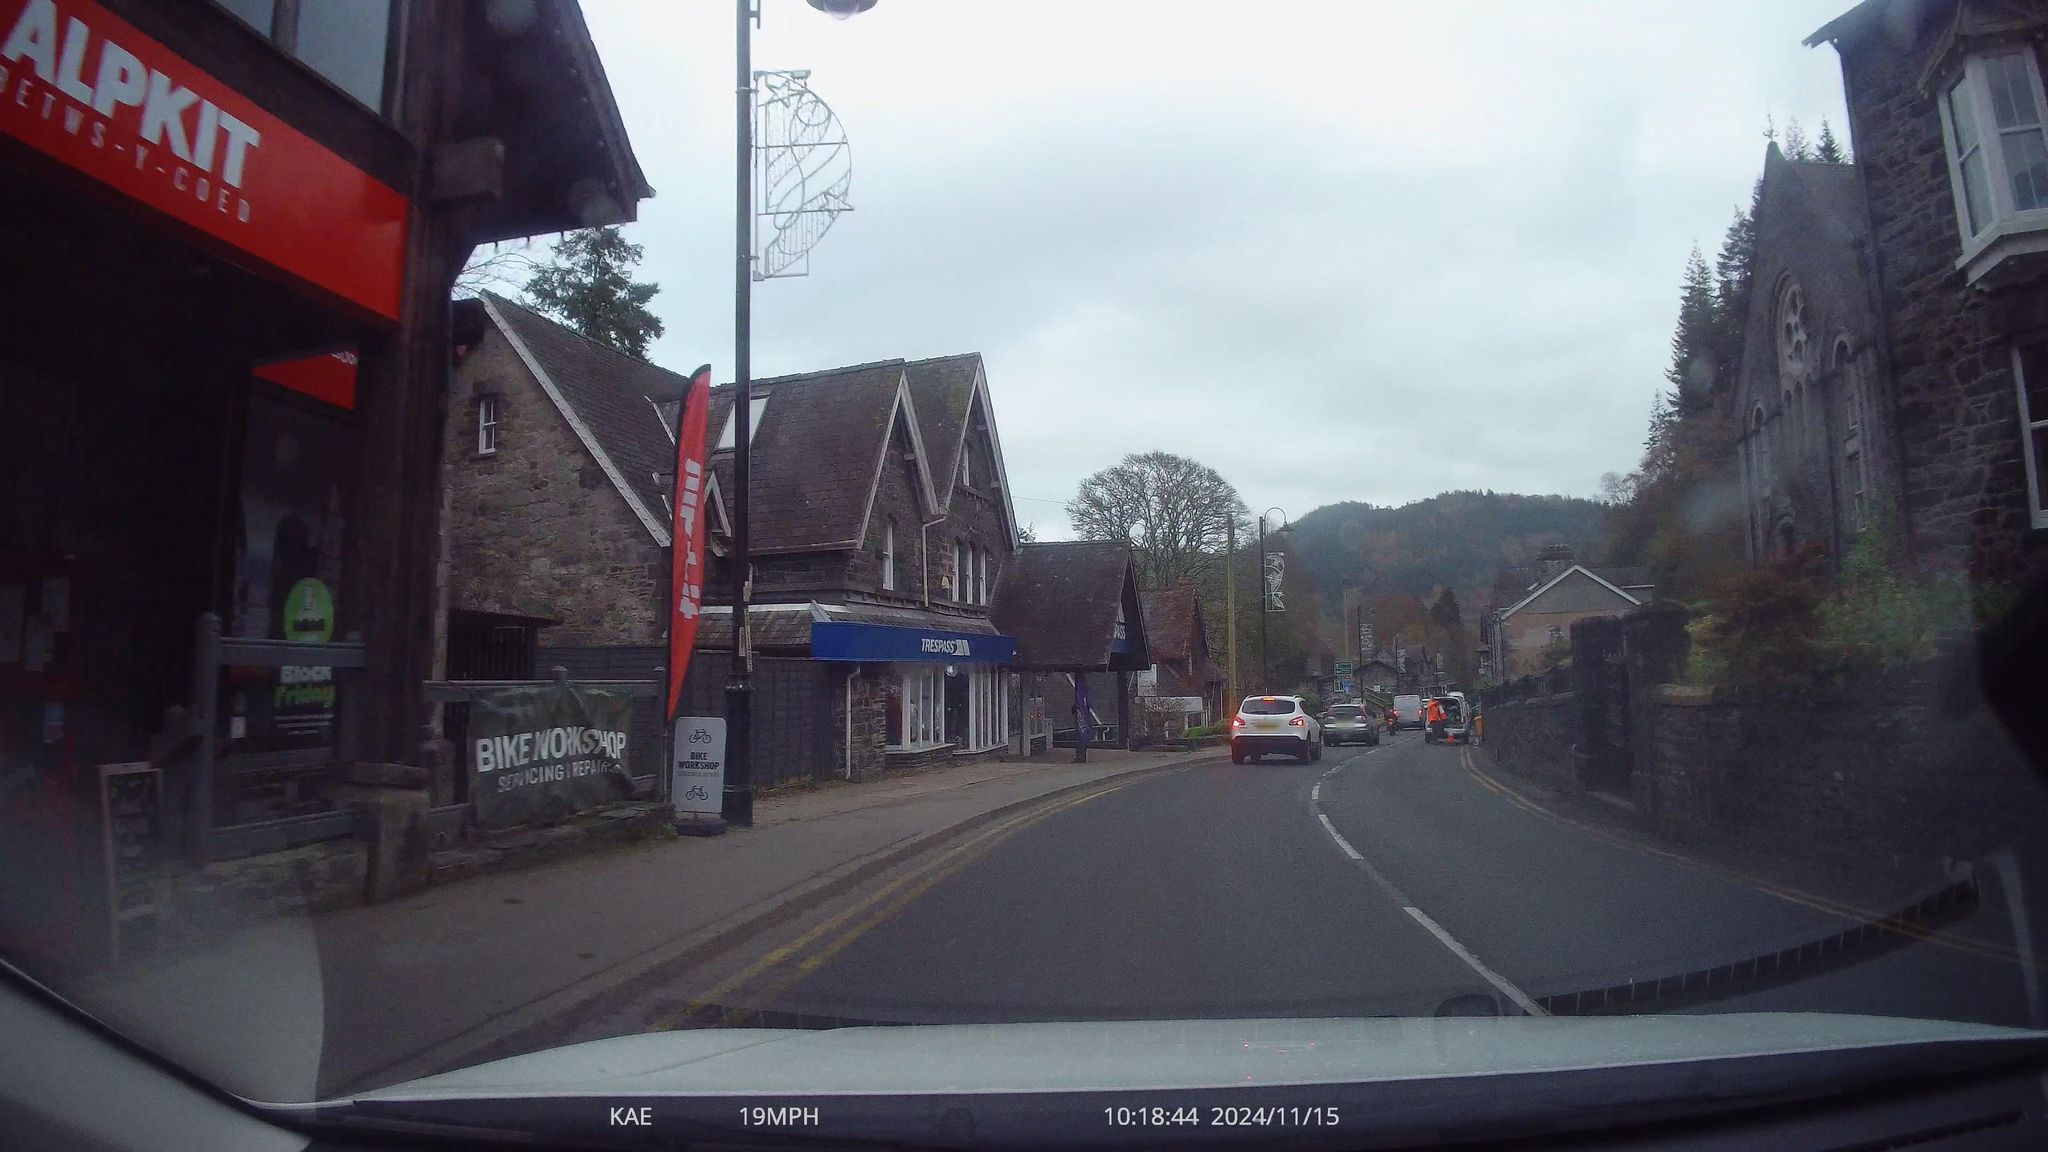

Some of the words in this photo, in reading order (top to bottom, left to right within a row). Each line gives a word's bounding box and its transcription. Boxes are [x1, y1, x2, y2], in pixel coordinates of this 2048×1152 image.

[1, 0, 261, 188] ALPKIT
[921, 638, 957, 654] TRESPASS
[476, 733, 533, 772] BIKE
[533, 727, 627, 760] WORKSHOP
[690, 752, 709, 760] BIKE
[498, 764, 565, 792] SERVICING
[572, 759, 621, 777] REPAIR
[678, 761, 720, 770] WORKSHOP
